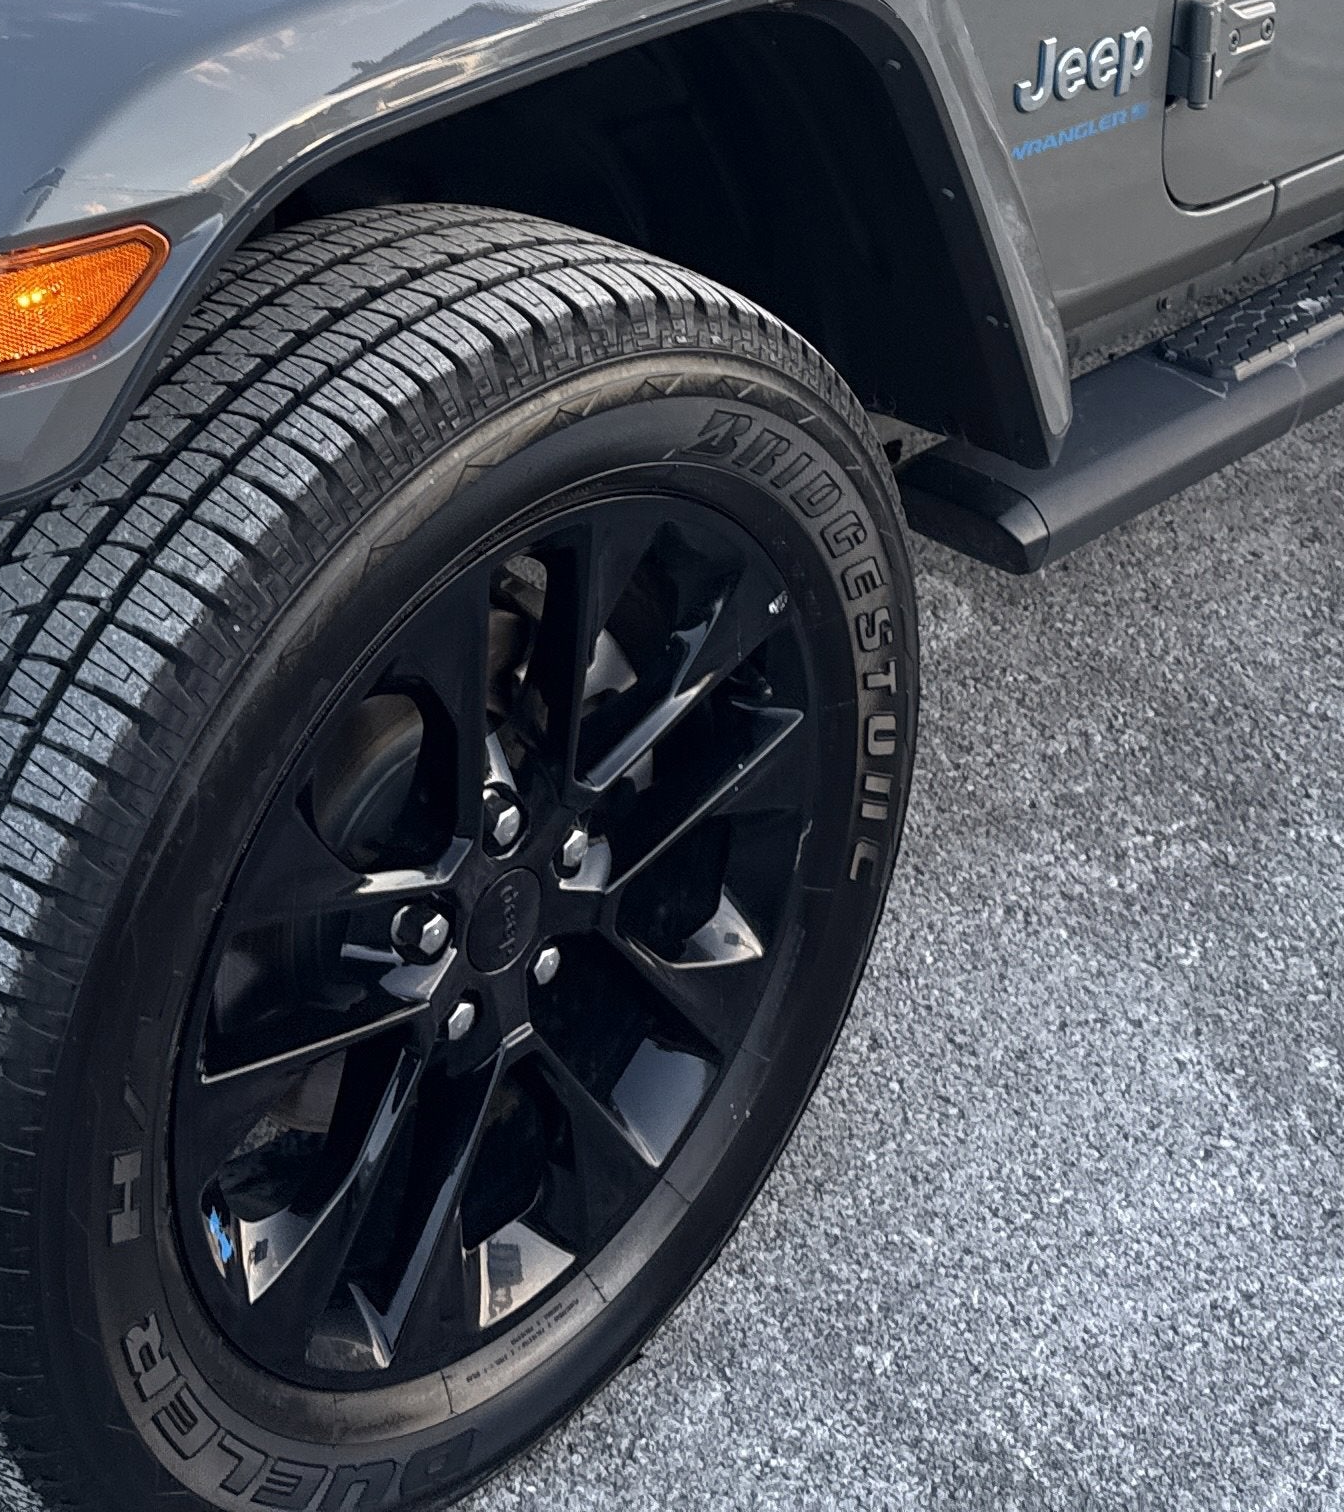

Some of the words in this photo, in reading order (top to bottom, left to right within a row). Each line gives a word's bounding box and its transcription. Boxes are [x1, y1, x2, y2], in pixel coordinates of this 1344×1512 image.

[1013, 25, 1153, 114] Jeep
[1010, 109, 1128, 162] WRANGLER
[120, 1311, 482, 1512] DUELER
